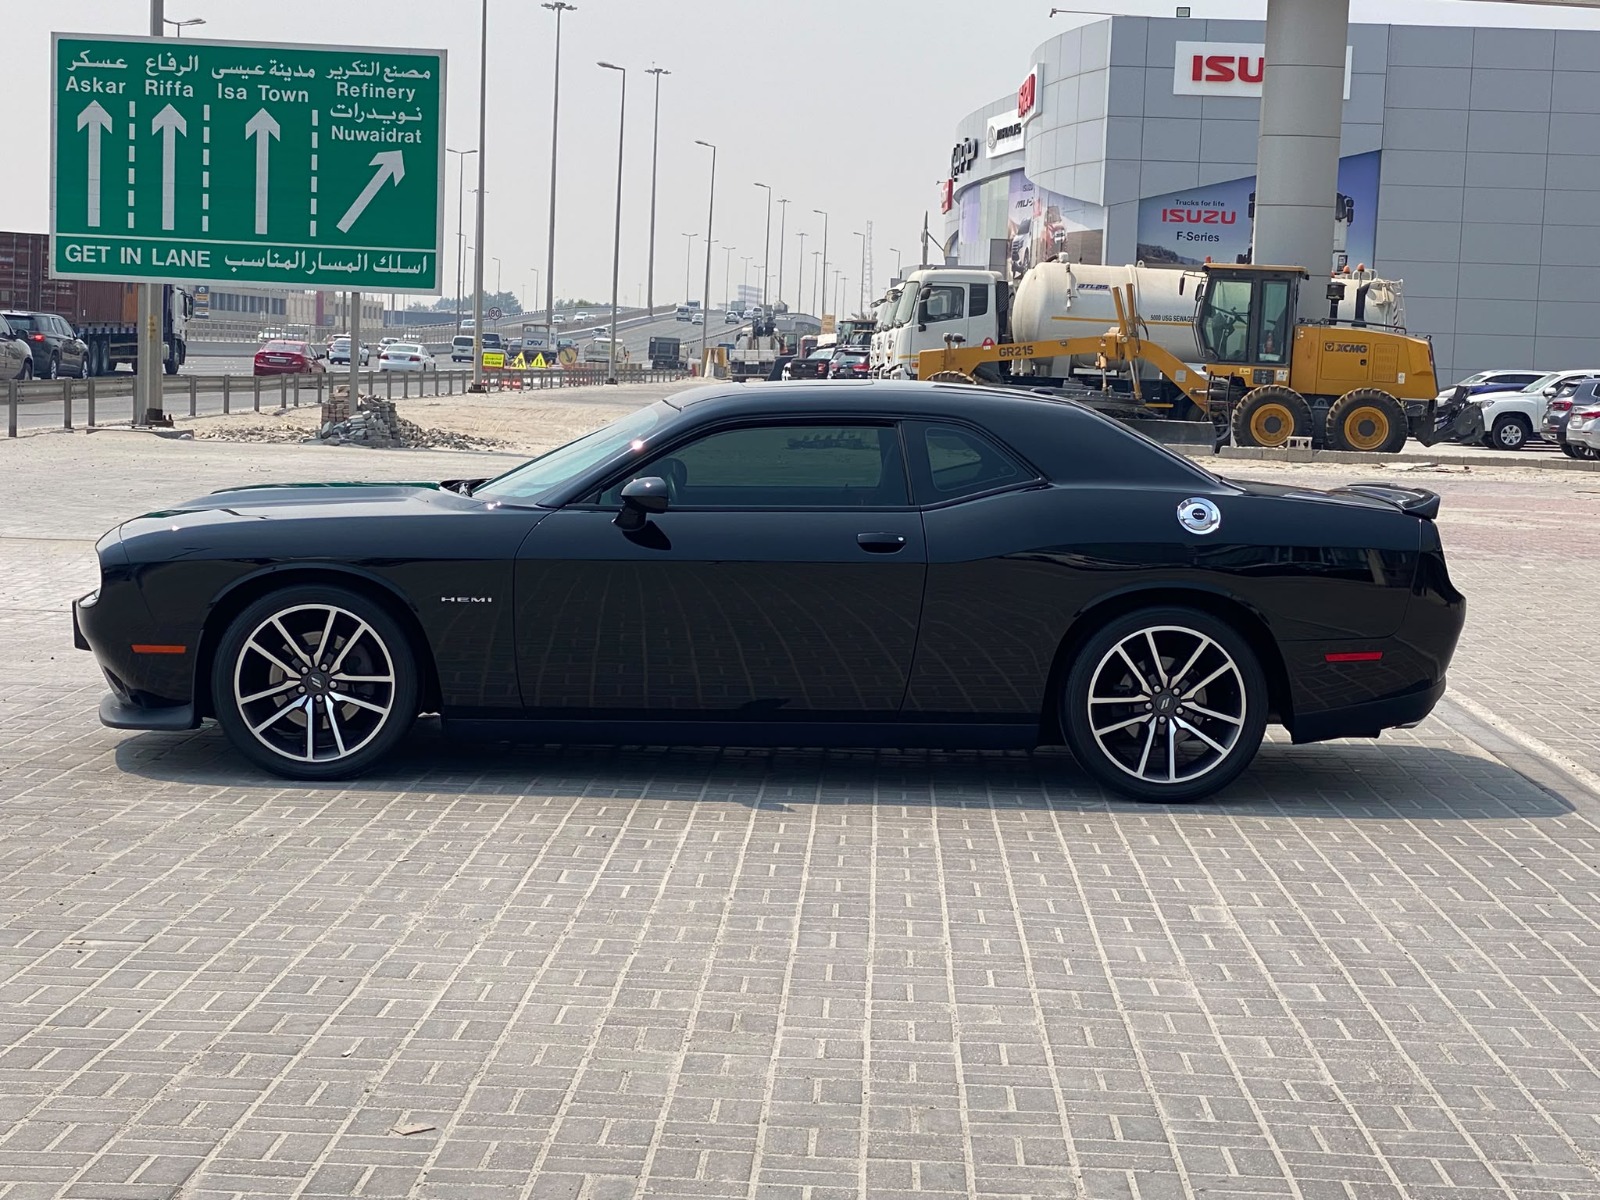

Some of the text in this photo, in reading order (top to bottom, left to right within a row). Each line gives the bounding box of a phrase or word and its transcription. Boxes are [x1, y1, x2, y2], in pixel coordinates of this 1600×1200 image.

[66, 49, 128, 71] عسكر
[145, 52, 199, 76] الرفاع
[211, 59, 316, 81] مدينة عيسى
[1191, 54, 1265, 83] ISU
[325, 60, 432, 83] مصنع التكرير
[65, 75, 126, 94] Askar
[145, 79, 194, 98] Riffa
[217, 82, 309, 102] Isa Town
[336, 81, 416, 102] Refinery
[330, 102, 423, 124] نويدرات
[331, 125, 422, 144] Nuwaidrat
[1161, 208, 1237, 225] ISUZU
[1176, 231, 1220, 242] F-Series
[65, 244, 211, 268] GET IN LANE
[224, 248, 428, 275] اسلك المسار المناسب
[490, 309, 499, 317] 80
[999, 345, 1034, 357] GR215
[1335, 343, 1368, 354] XCMG
